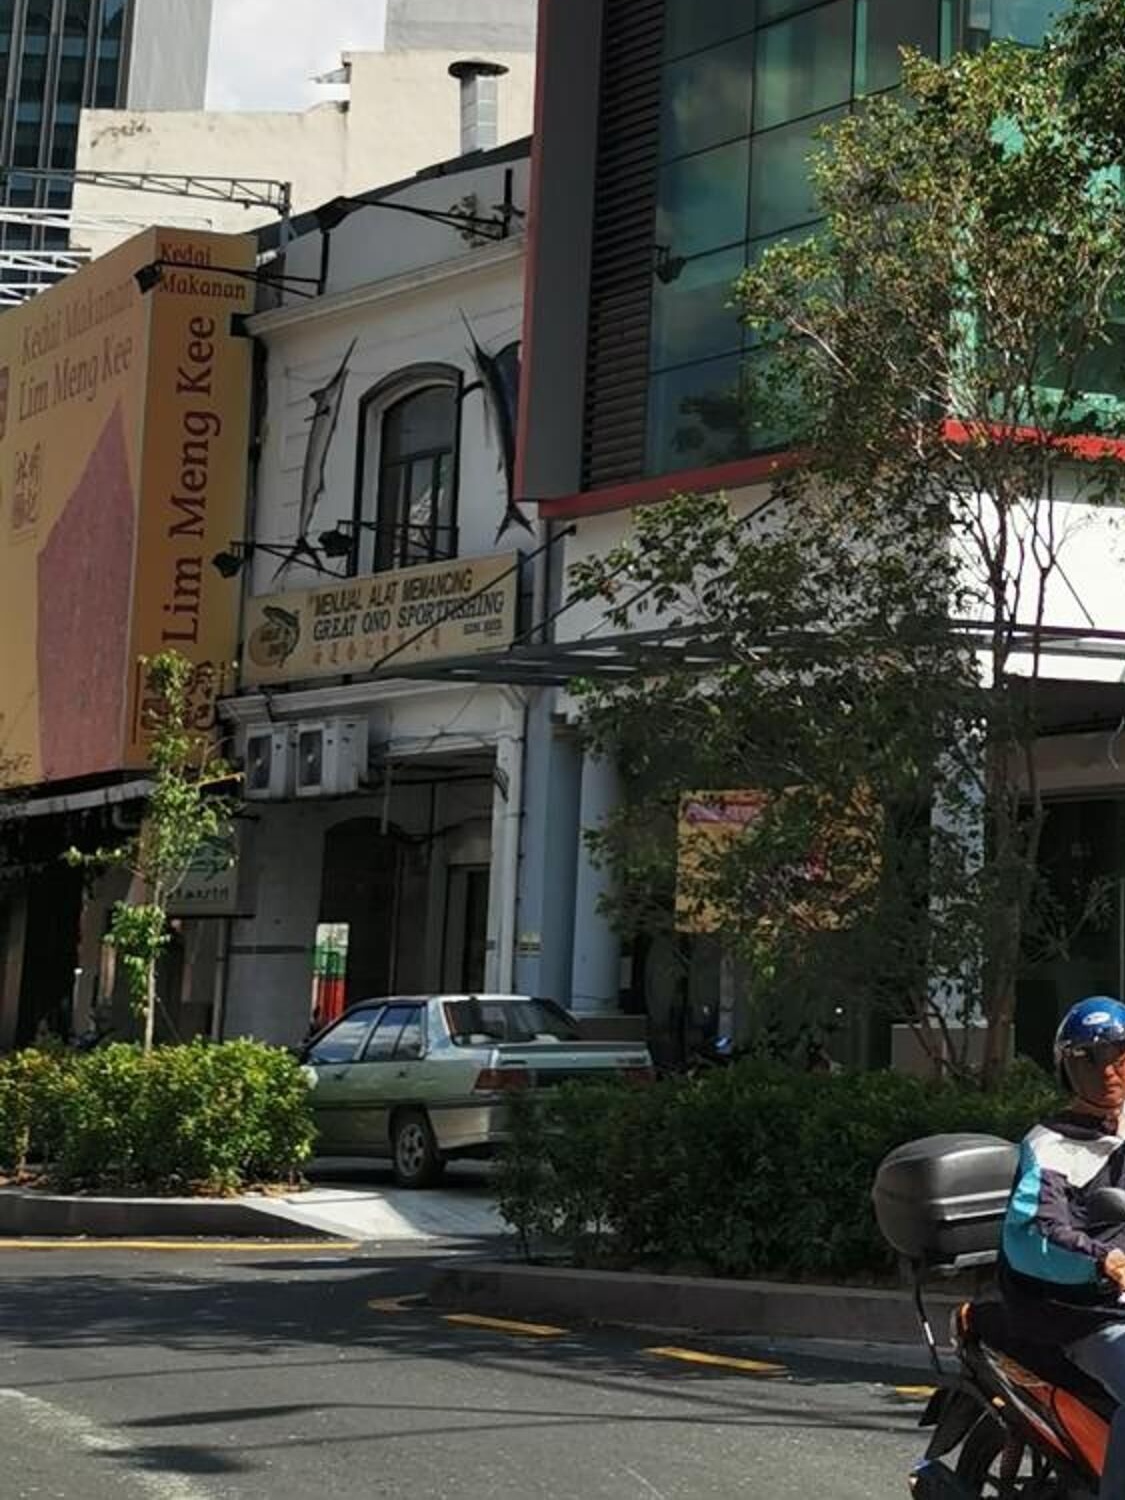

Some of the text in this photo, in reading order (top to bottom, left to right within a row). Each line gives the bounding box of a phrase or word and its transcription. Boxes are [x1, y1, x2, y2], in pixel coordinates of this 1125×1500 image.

[19, 335, 134, 421] Lim Meng Kee
[176, 315, 216, 397] Kee
[168, 409, 222, 539] Meng
[161, 556, 203, 645] Lim
[313, 613, 358, 641] GREAT
[361, 608, 391, 634] ONO
